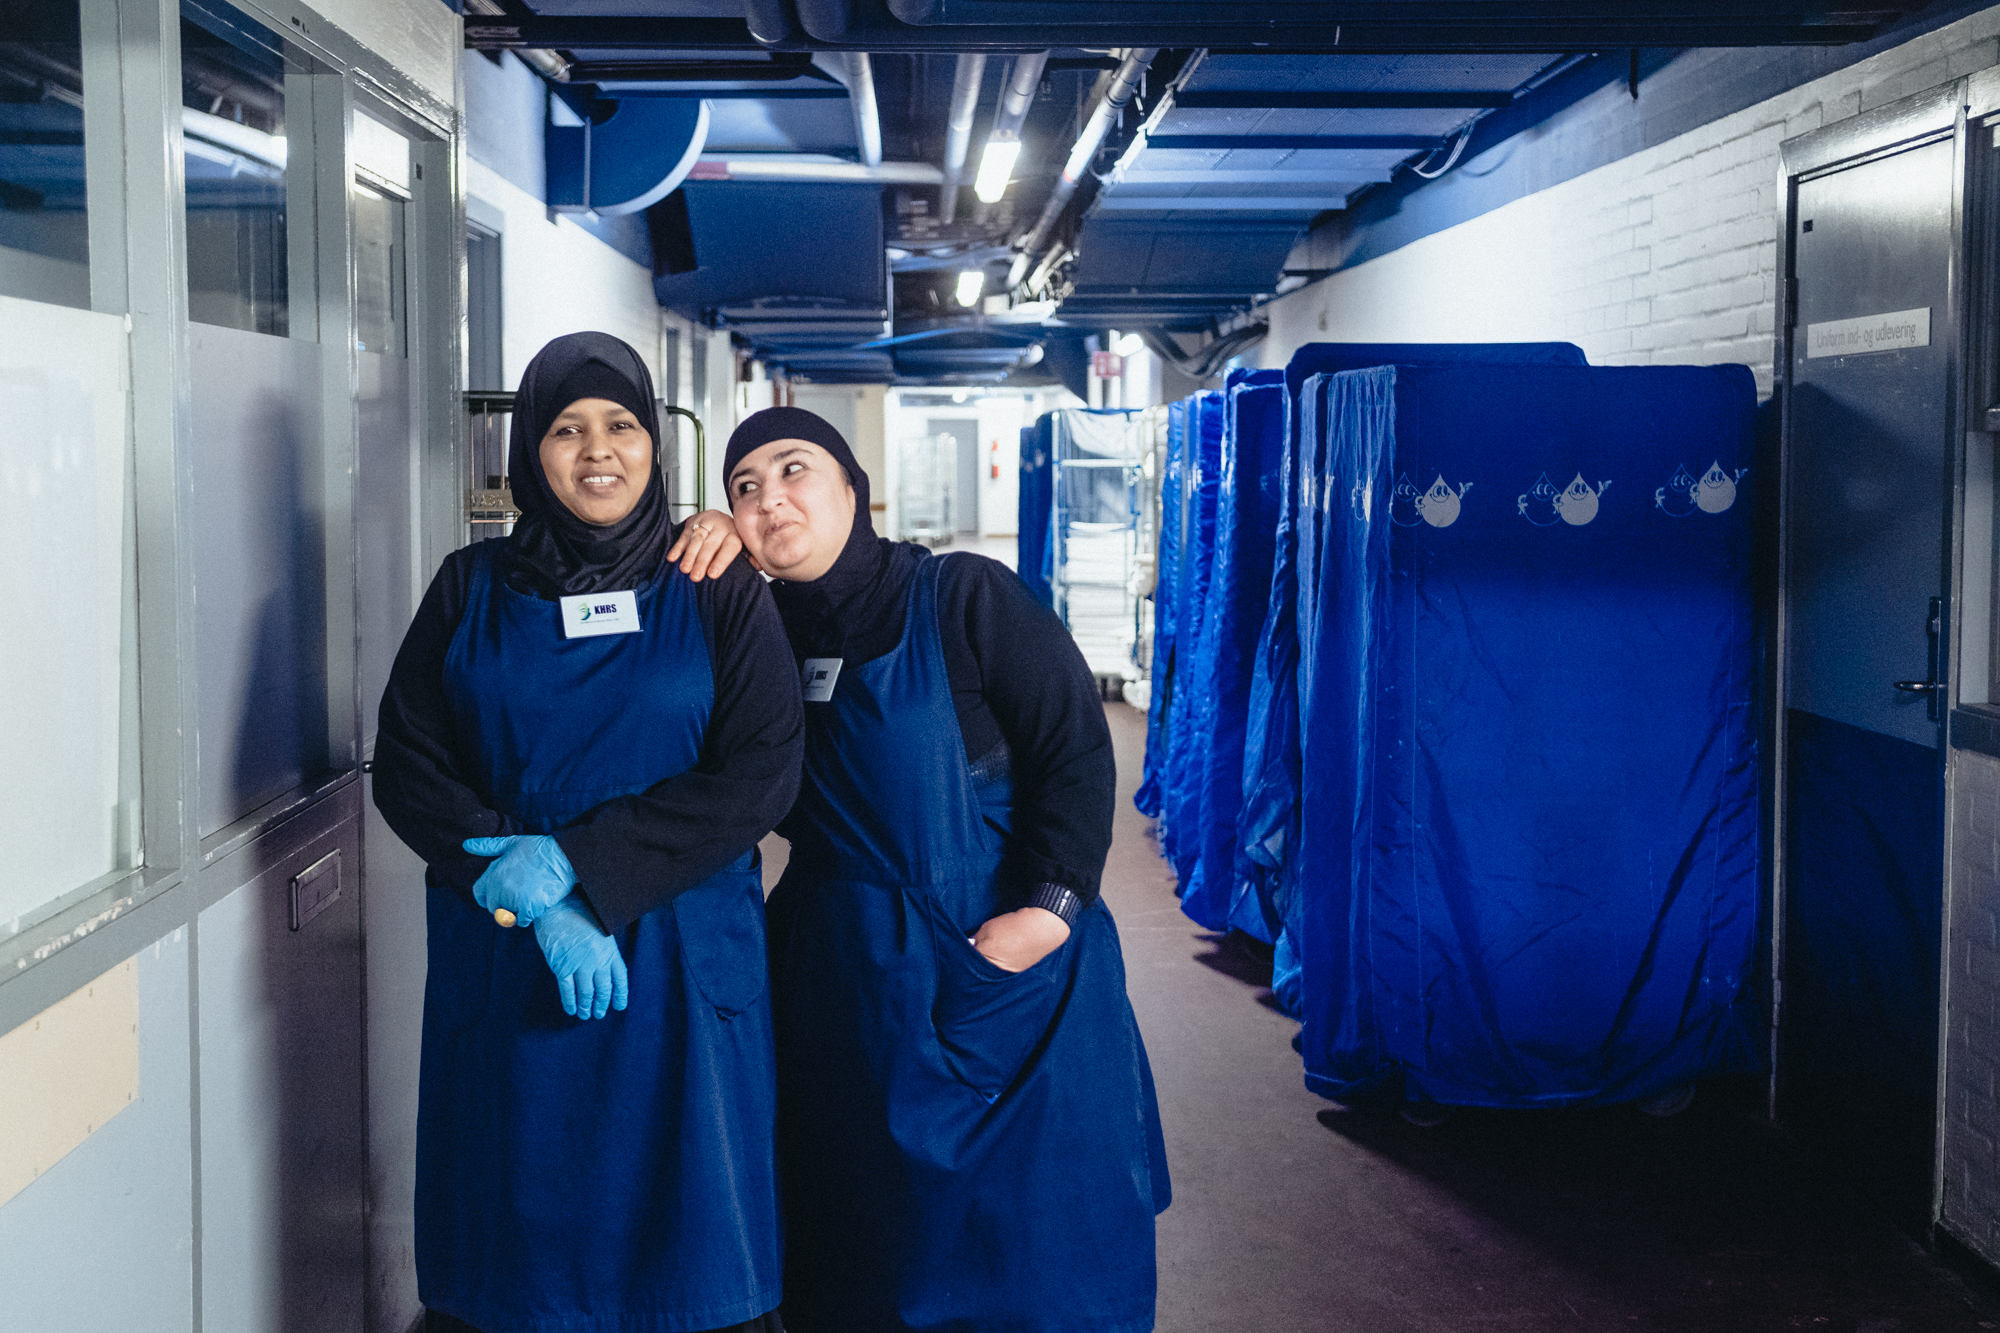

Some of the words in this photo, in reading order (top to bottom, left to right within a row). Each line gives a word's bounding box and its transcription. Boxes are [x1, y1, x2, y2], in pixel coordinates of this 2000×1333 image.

[1816, 329, 1846, 349] Uniform
[1847, 326, 1862, 345] ind-
[1863, 328, 1874, 348] og
[1875, 320, 1916, 343] udlevering
[594, 603, 617, 615] KHRS
